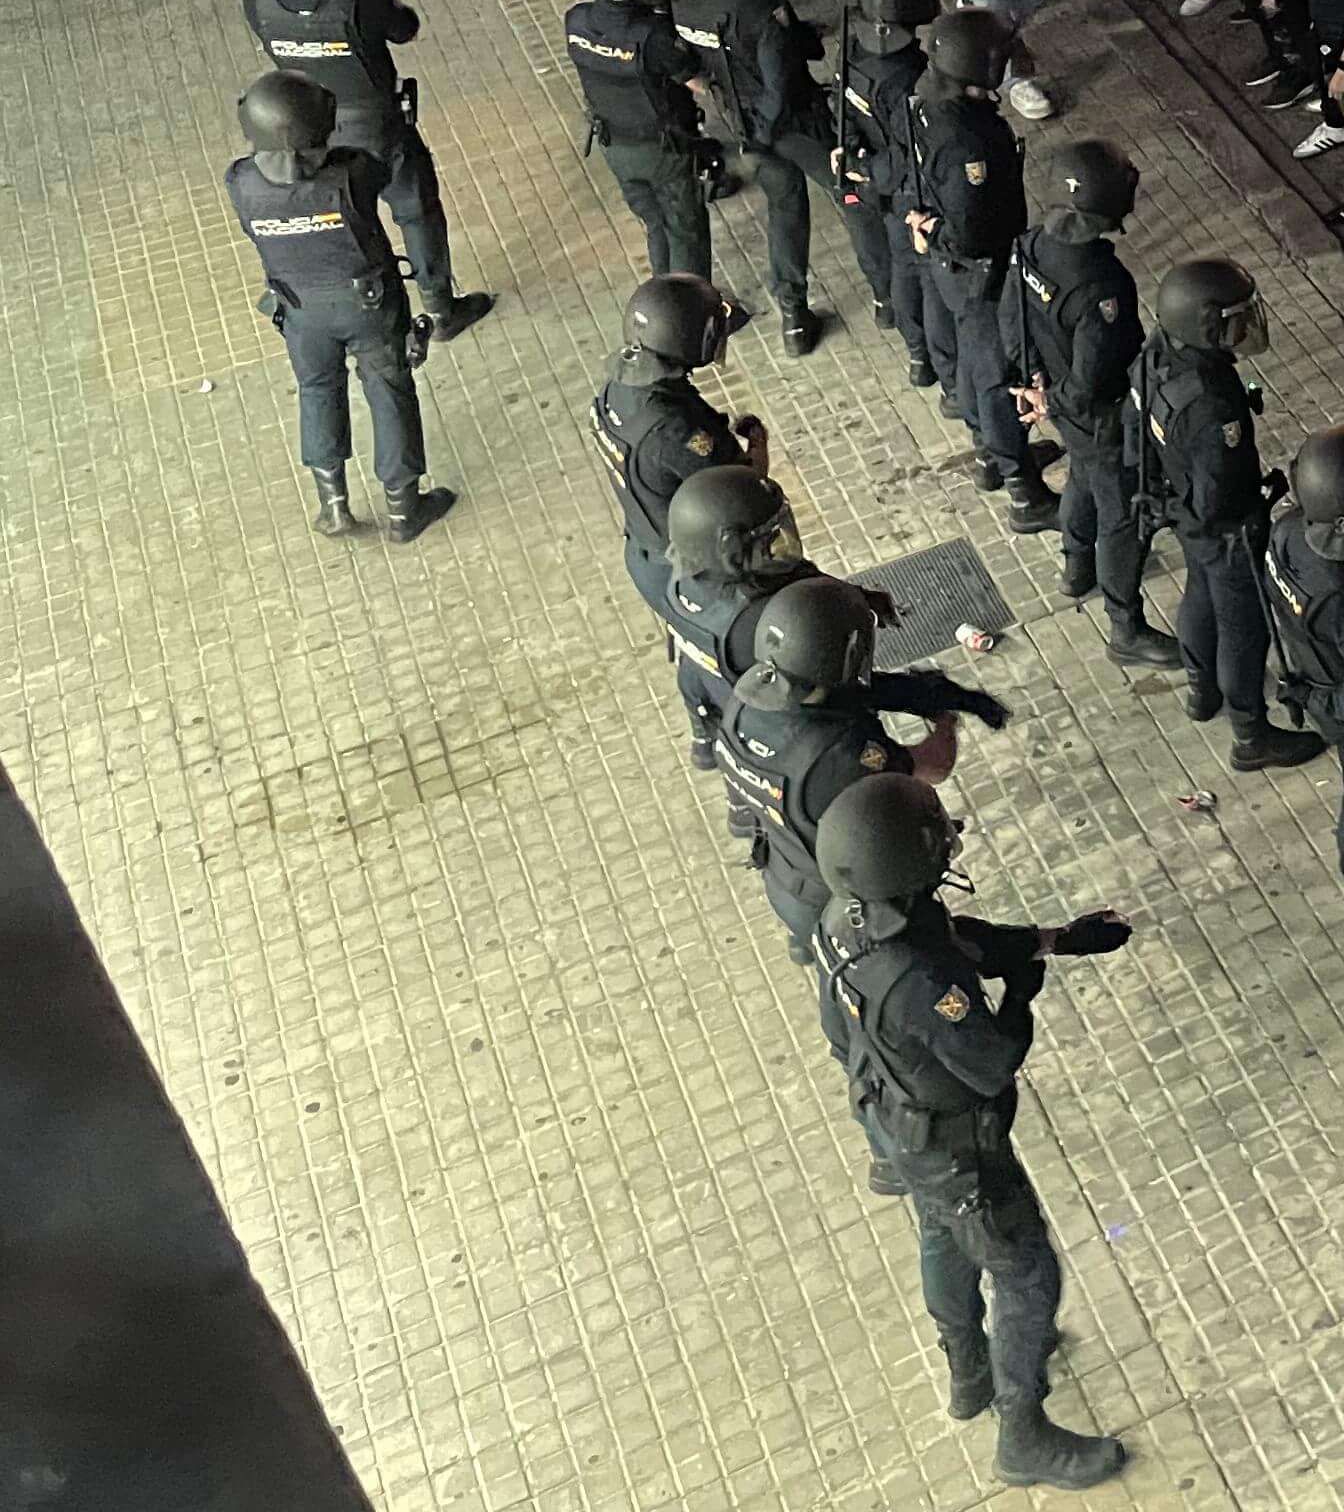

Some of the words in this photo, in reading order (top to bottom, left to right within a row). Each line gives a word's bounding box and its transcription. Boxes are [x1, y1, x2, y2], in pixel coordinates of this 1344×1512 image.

[271, 40, 330, 50] POLICIA
[273, 48, 352, 57] NACIONAL
[251, 214, 322, 227] POLICIA
[253, 222, 345, 236] NACIONAL
